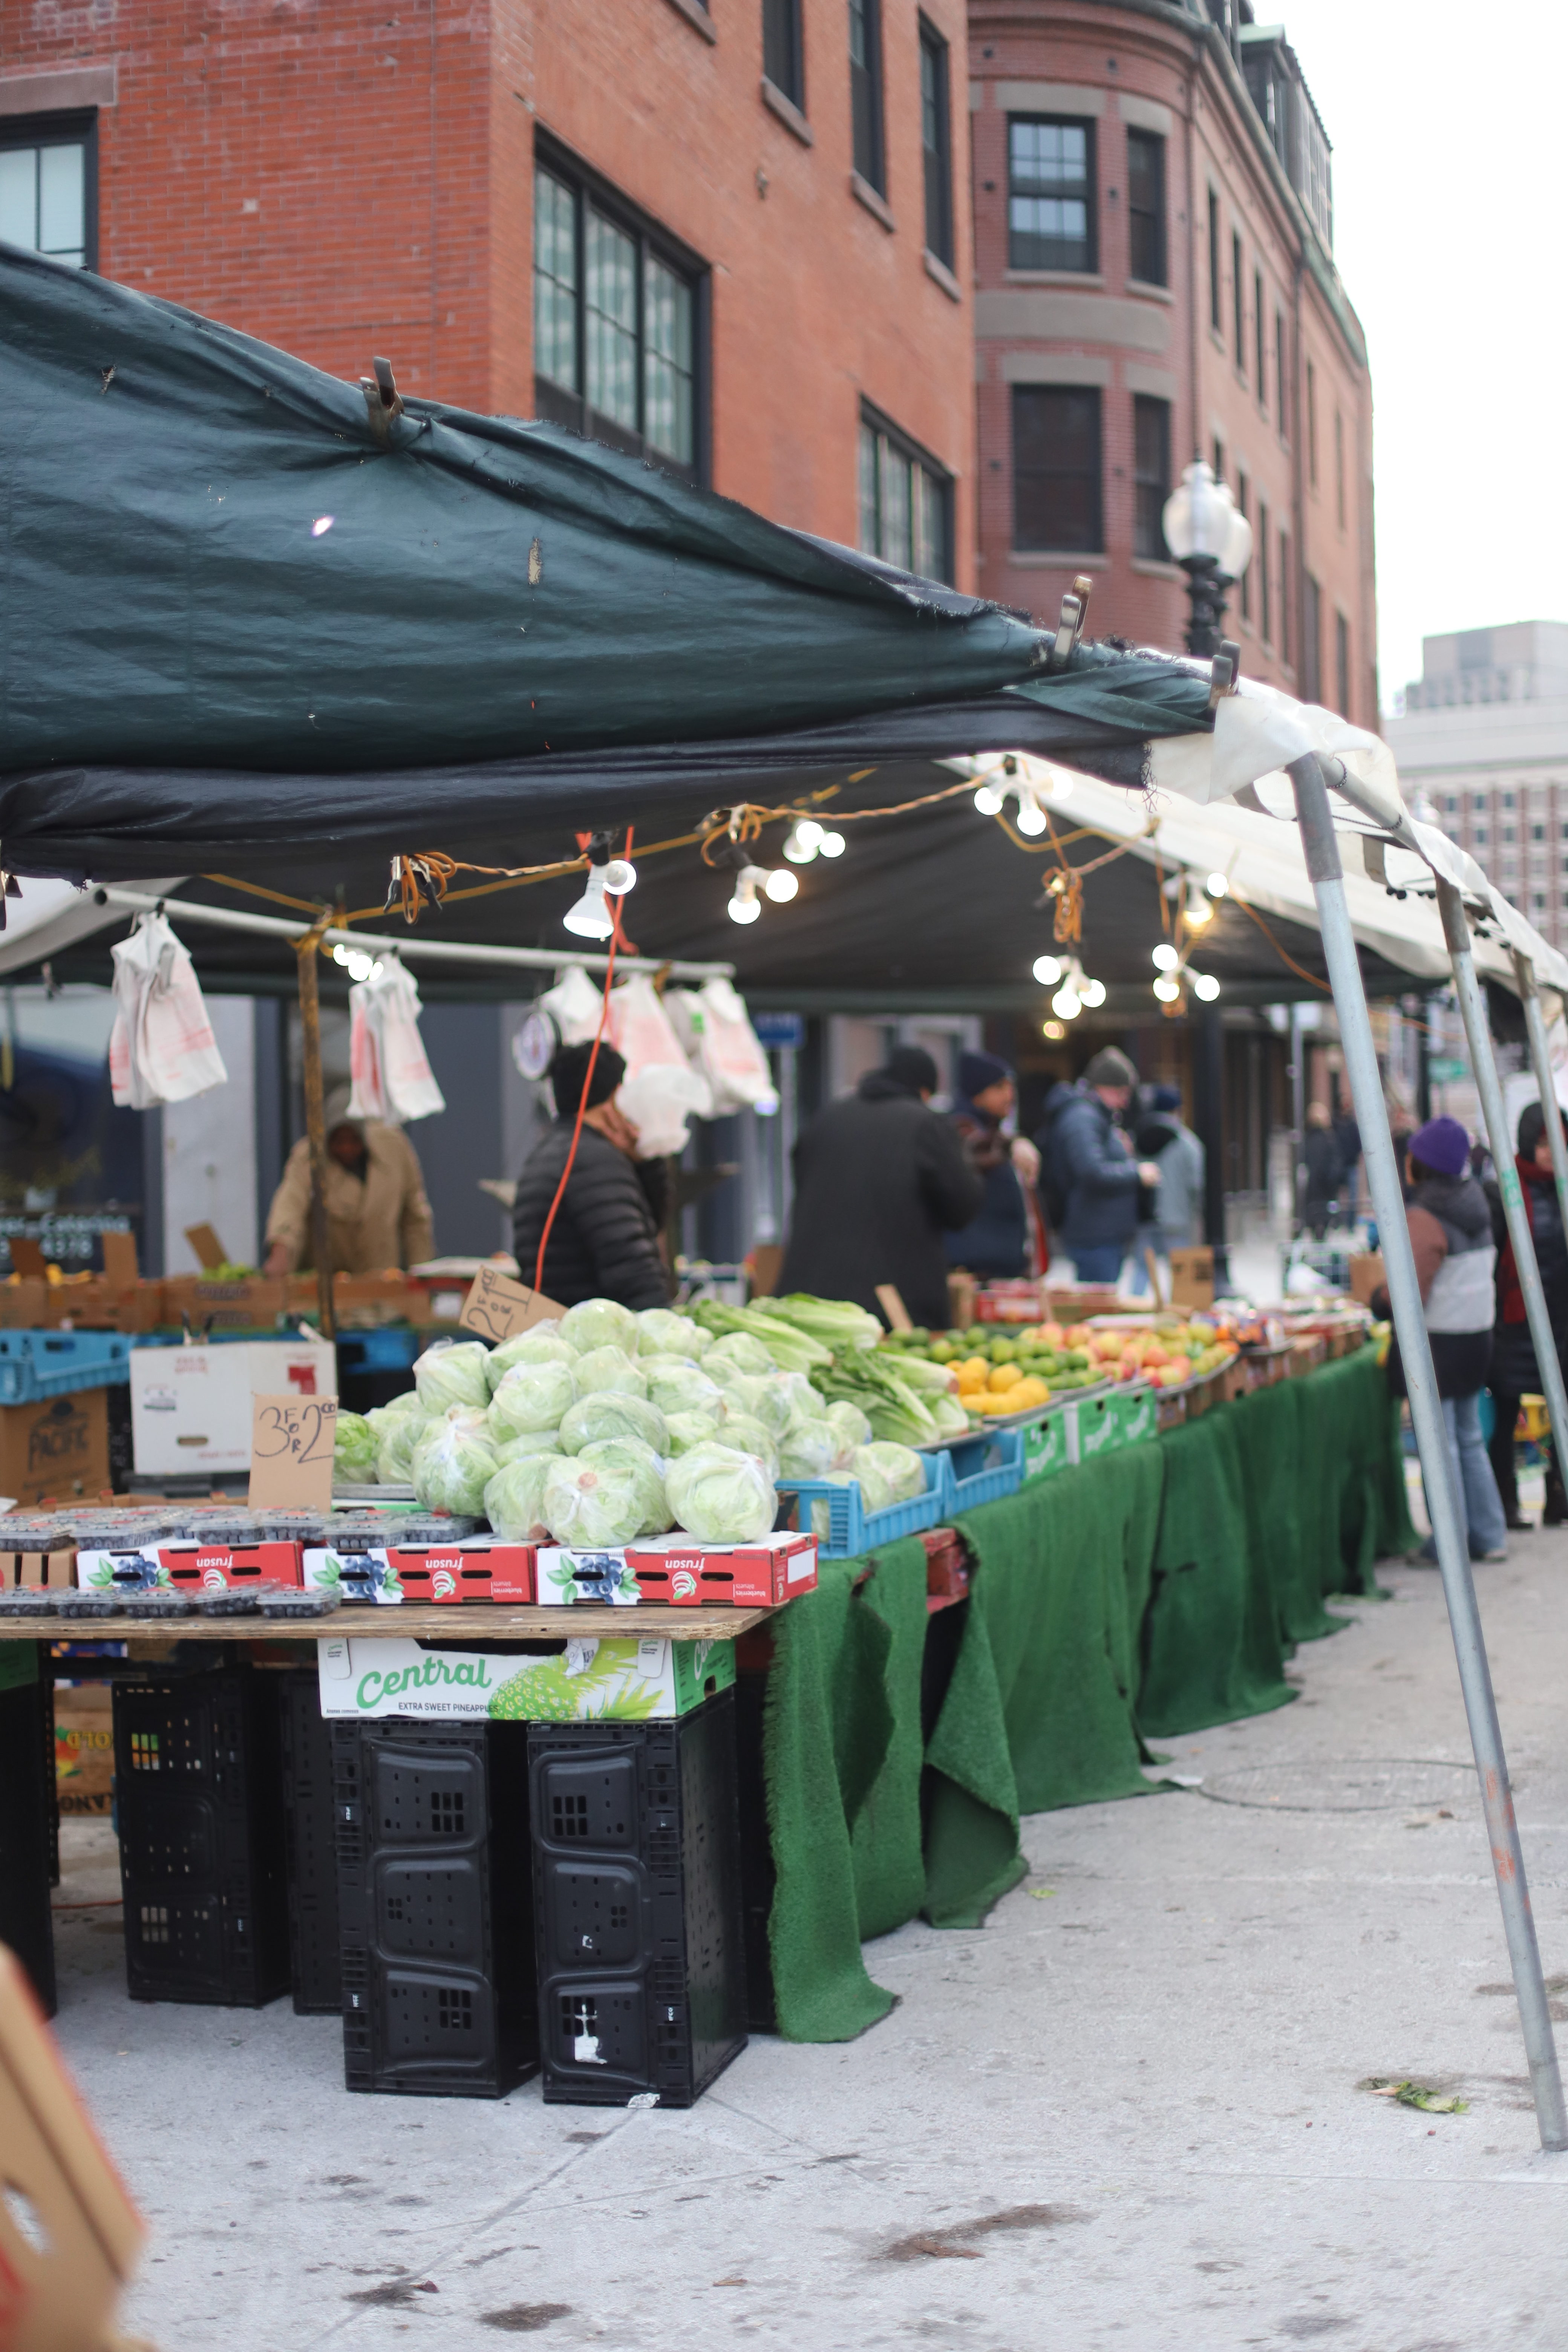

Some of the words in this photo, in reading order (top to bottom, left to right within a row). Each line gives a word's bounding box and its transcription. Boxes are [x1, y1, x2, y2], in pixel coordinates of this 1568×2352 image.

[196, 1554, 233, 1568] frusan
[425, 1556, 464, 1571] frusan
[665, 1557, 705, 1571] frusan
[356, 1656, 492, 1709] Central
[398, 1702, 423, 1710] EXTRA
[424, 1702, 451, 1712] SWEET
[453, 1703, 499, 1712] PINEAPPLES
